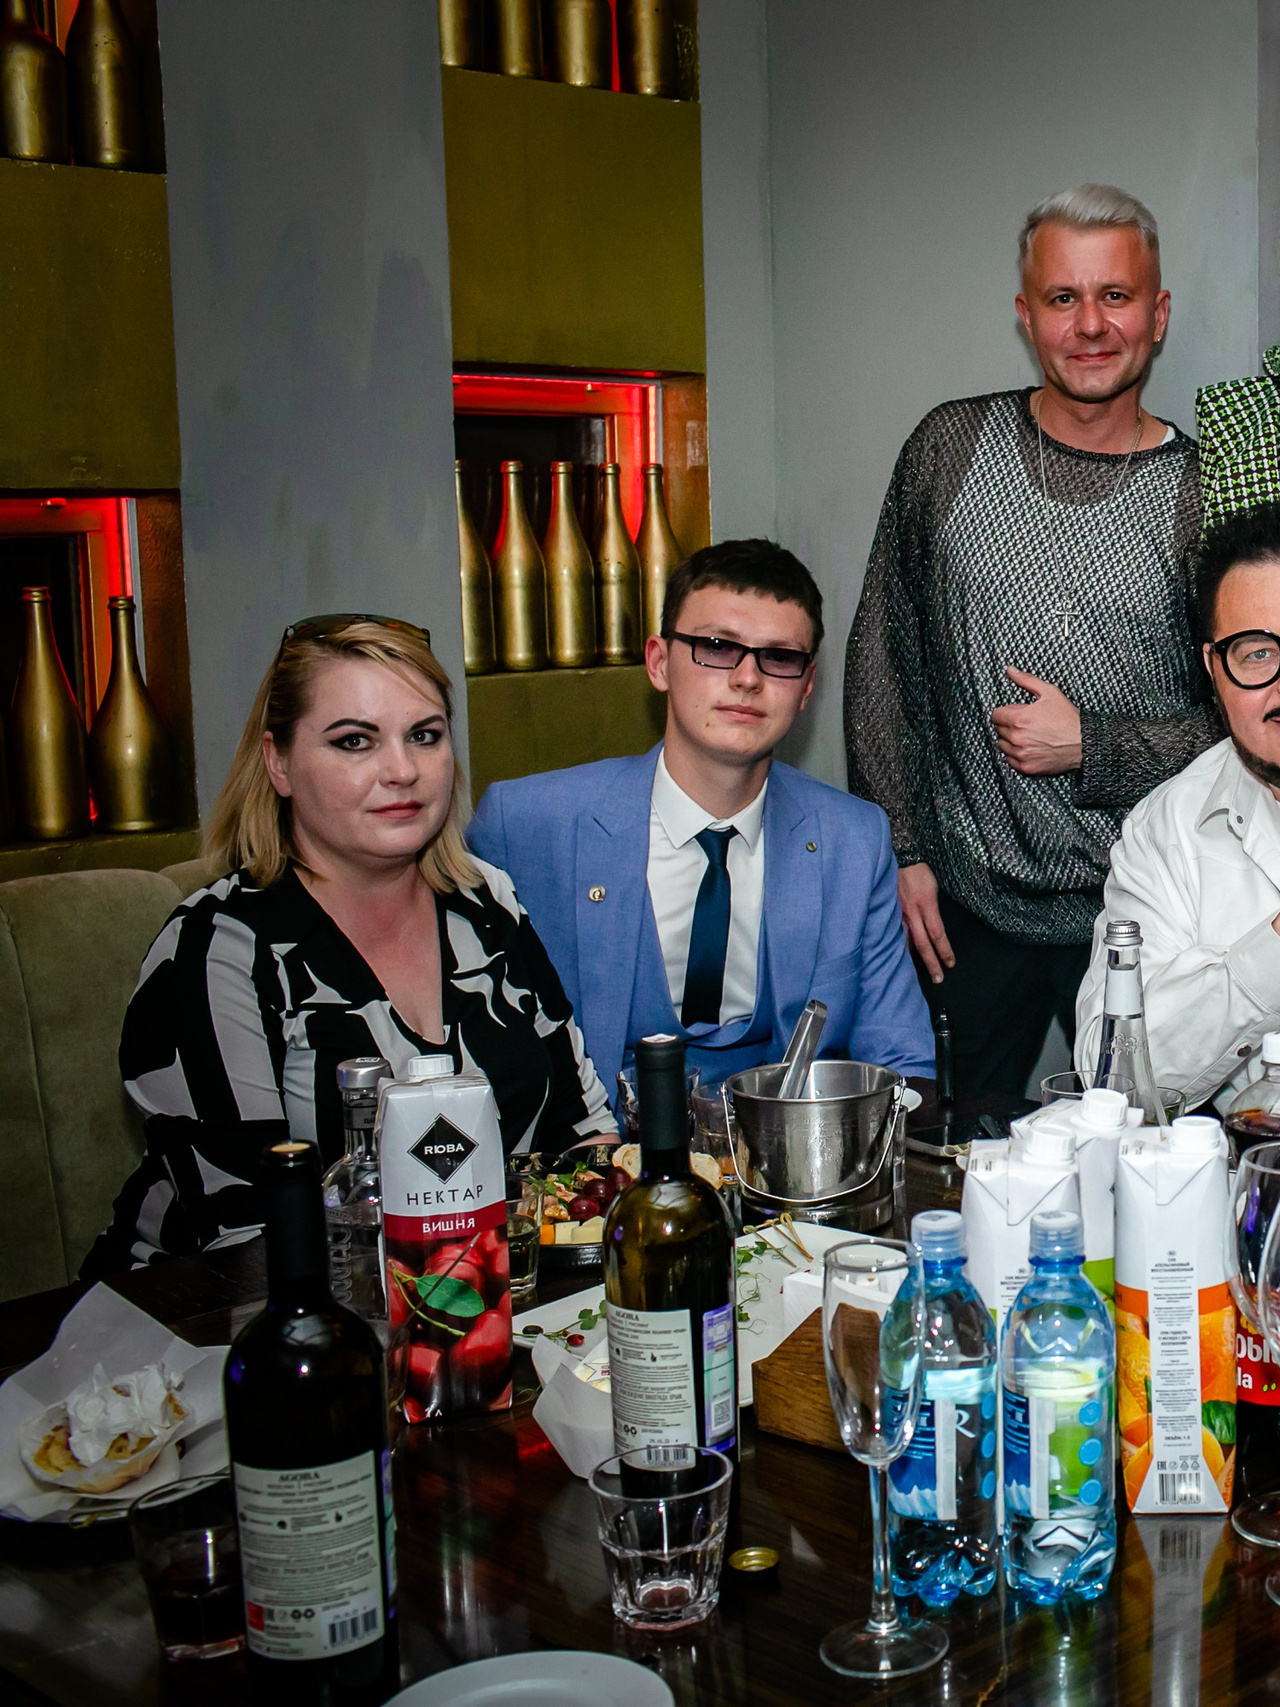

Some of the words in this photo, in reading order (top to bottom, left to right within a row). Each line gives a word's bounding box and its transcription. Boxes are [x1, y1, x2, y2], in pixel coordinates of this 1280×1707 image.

[424, 1143, 465, 1155] RIOBA
[407, 1184, 483, 1206] НЕКТАР
[422, 1217, 475, 1233] ВИШНЯ
